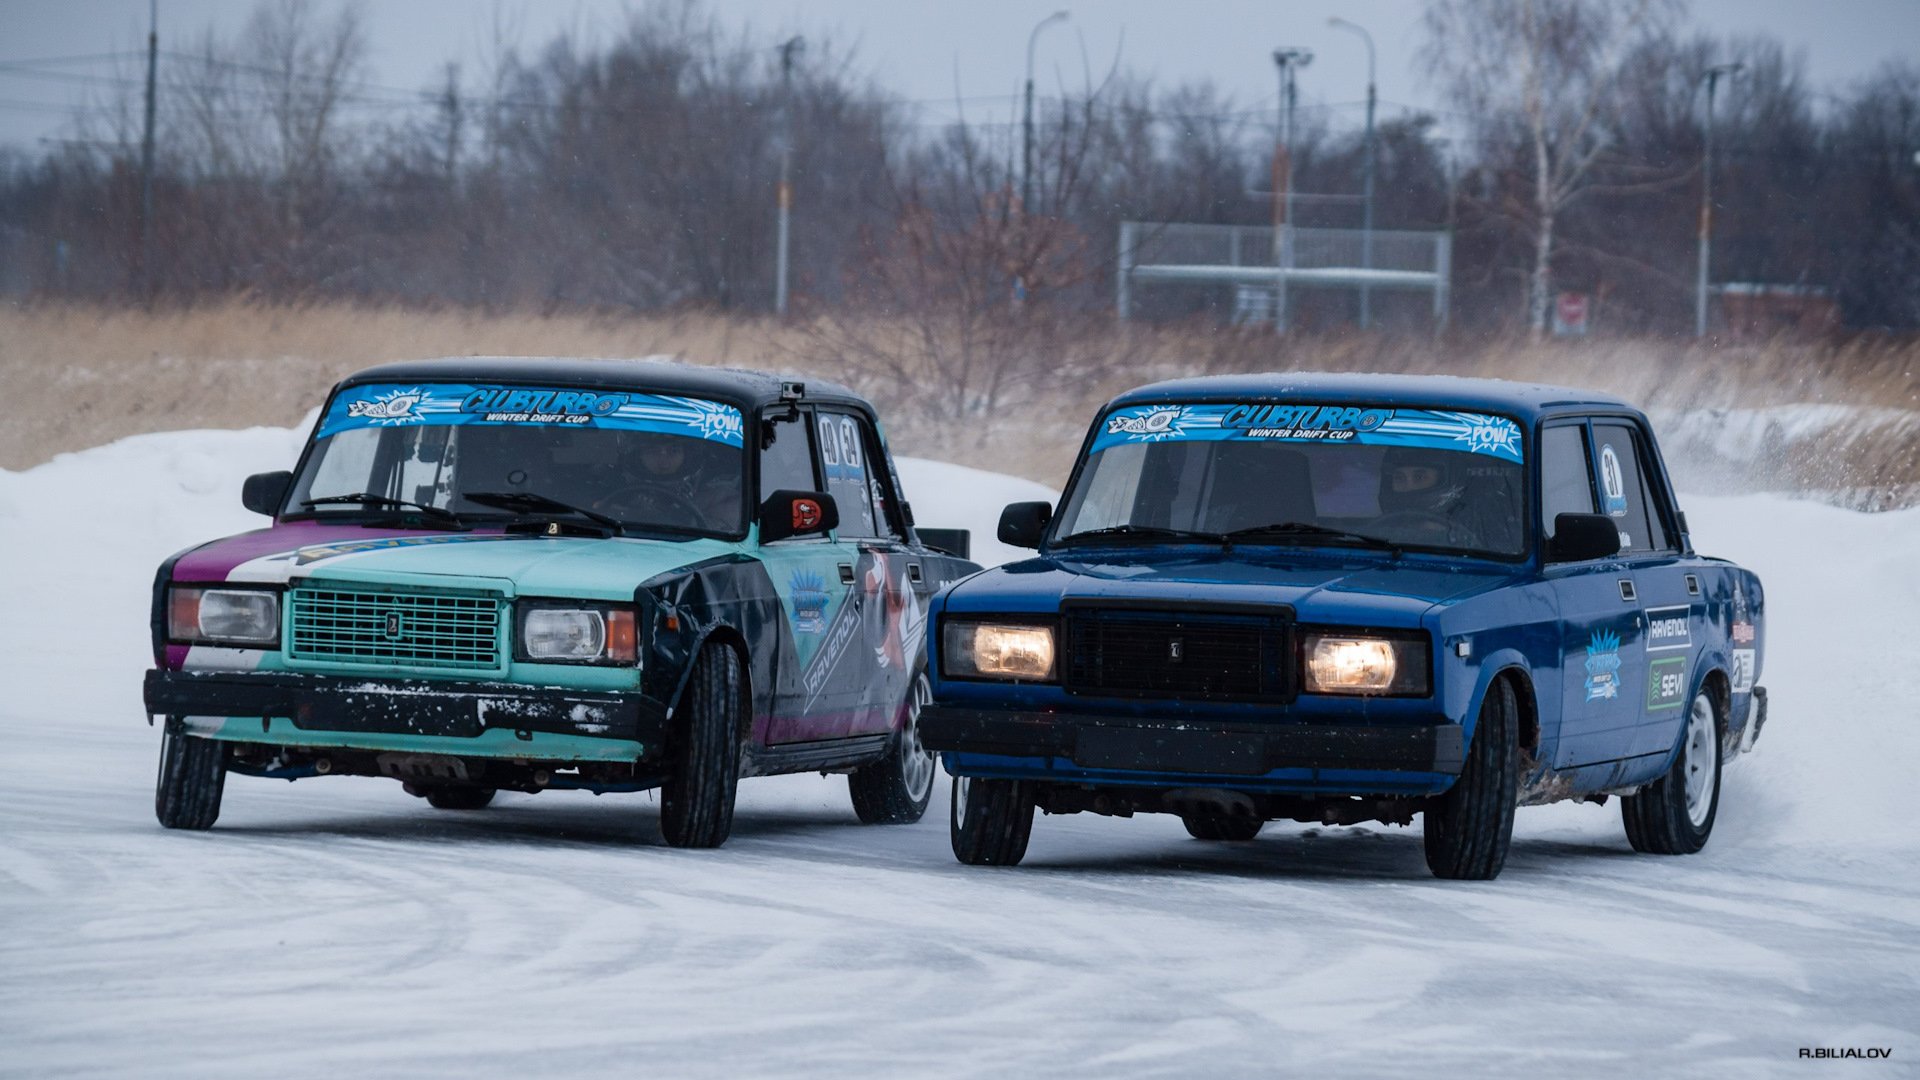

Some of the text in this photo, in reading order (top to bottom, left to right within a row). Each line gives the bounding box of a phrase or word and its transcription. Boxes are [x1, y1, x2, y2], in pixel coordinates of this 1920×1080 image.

[460, 388, 631, 417] CLUBTURBO
[486, 412, 590, 424] WINTER DRIFT CUP
[705, 412, 741, 431] POW
[1221, 404, 1395, 433] CLUBTURBO
[821, 421, 838, 465] 48
[841, 423, 858, 466] 54
[1248, 428, 1354, 440] WINTER DRIFT CUP
[1472, 425, 1510, 443] POW
[1604, 453, 1620, 497] 31
[1651, 618, 1688, 639] RAVENOL
[809, 609, 856, 696] RAVENOL
[1661, 672, 1685, 698] SEVI
